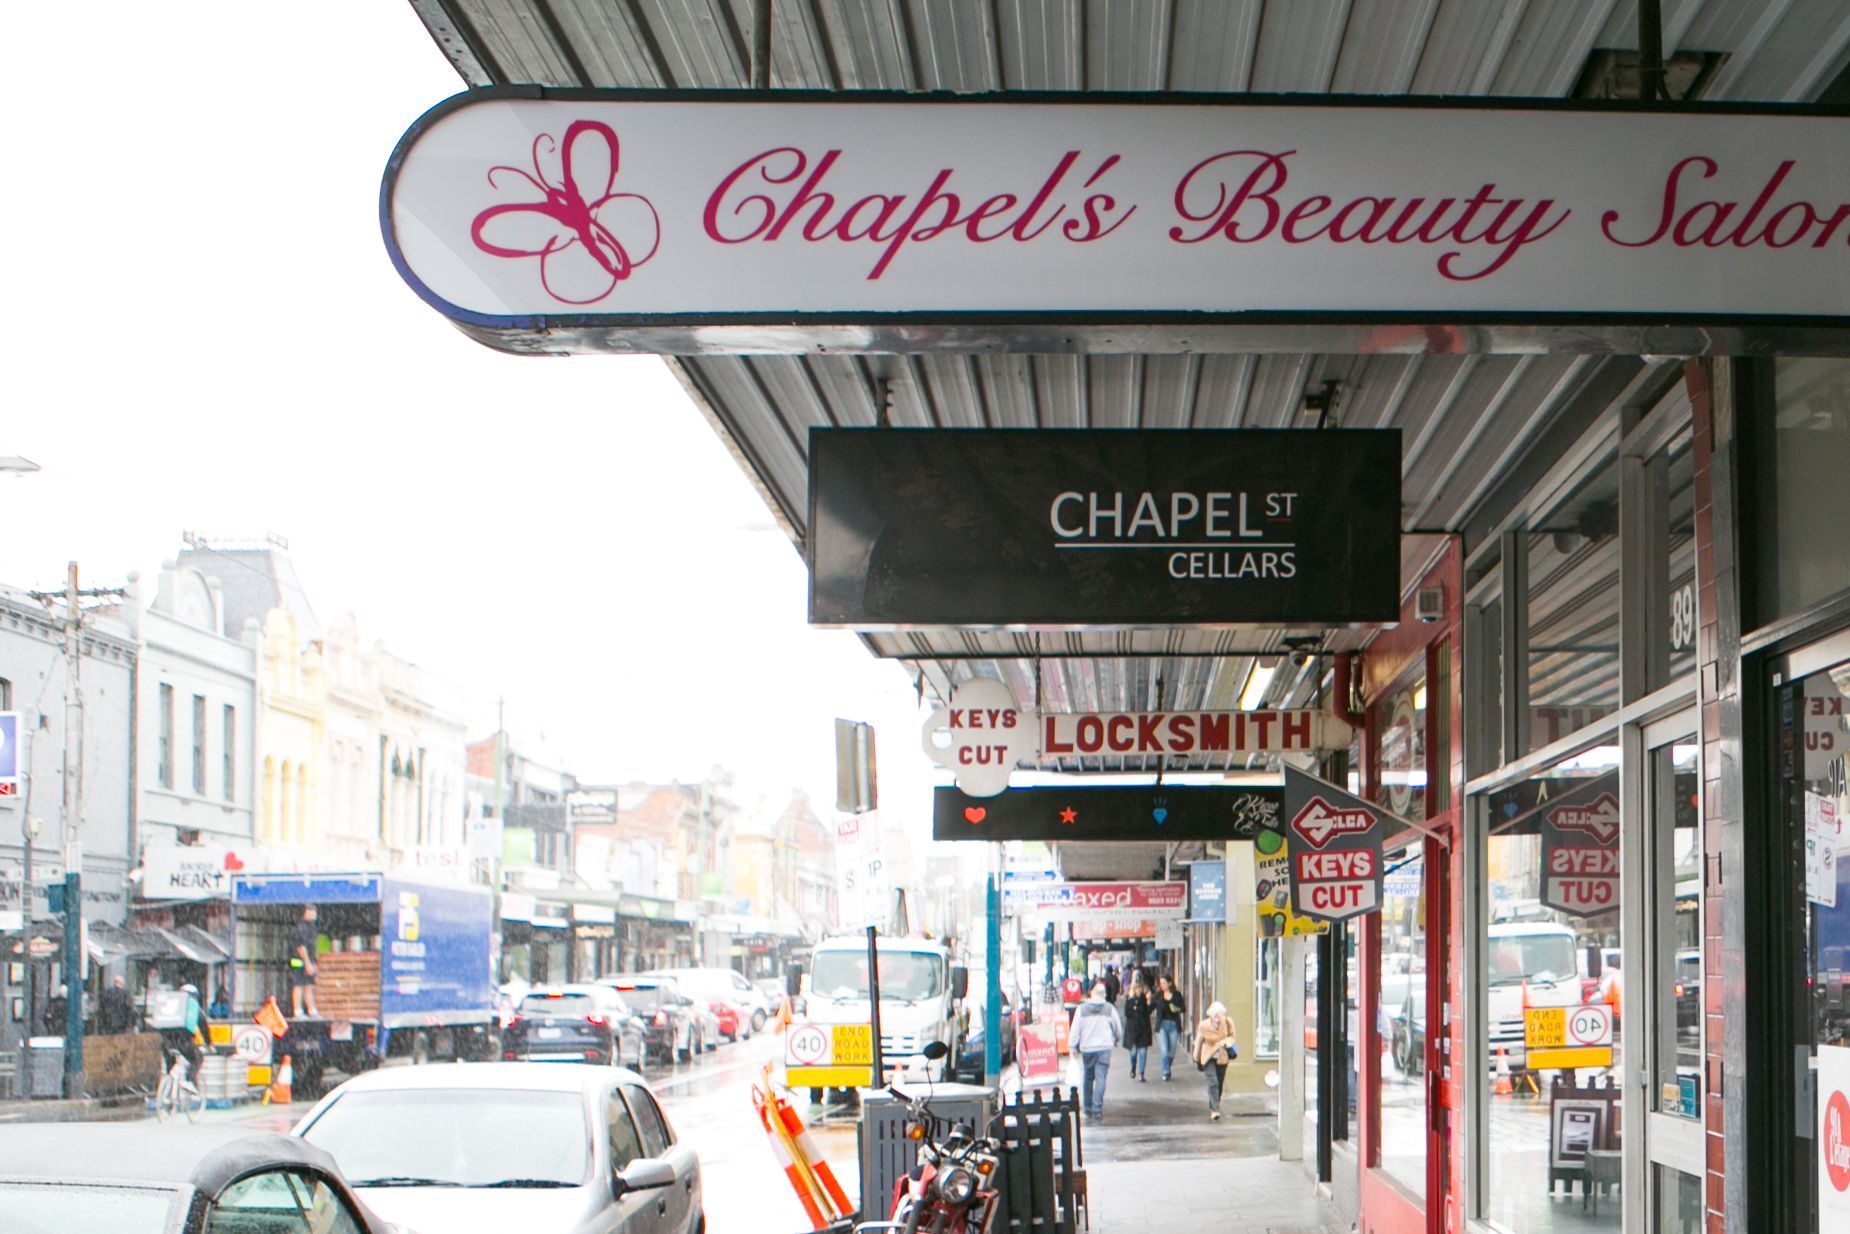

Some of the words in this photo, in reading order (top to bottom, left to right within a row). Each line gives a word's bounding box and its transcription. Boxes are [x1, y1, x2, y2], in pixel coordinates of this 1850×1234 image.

[702, 146, 1137, 280] Chapel's
[1168, 149, 1571, 281] Beauty
[1050, 491, 1263, 538] CHAPEL
[1265, 493, 1297, 516] ST
[1168, 552, 1297, 579] CELLARS
[1672, 585, 1693, 649] 89
[948, 708, 1018, 729] KEYS
[1045, 711, 1311, 753] LOCKSMITH
[958, 745, 1009, 766] CUT
[1302, 851, 1370, 879] KEYS
[1312, 884, 1364, 909] CUT
[237, 1036, 265, 1054] 40
[796, 1036, 821, 1053] 40
[840, 1026, 865, 1037] END
[835, 1038, 869, 1049] ROAD
[835, 1051, 869, 1062] WORK
